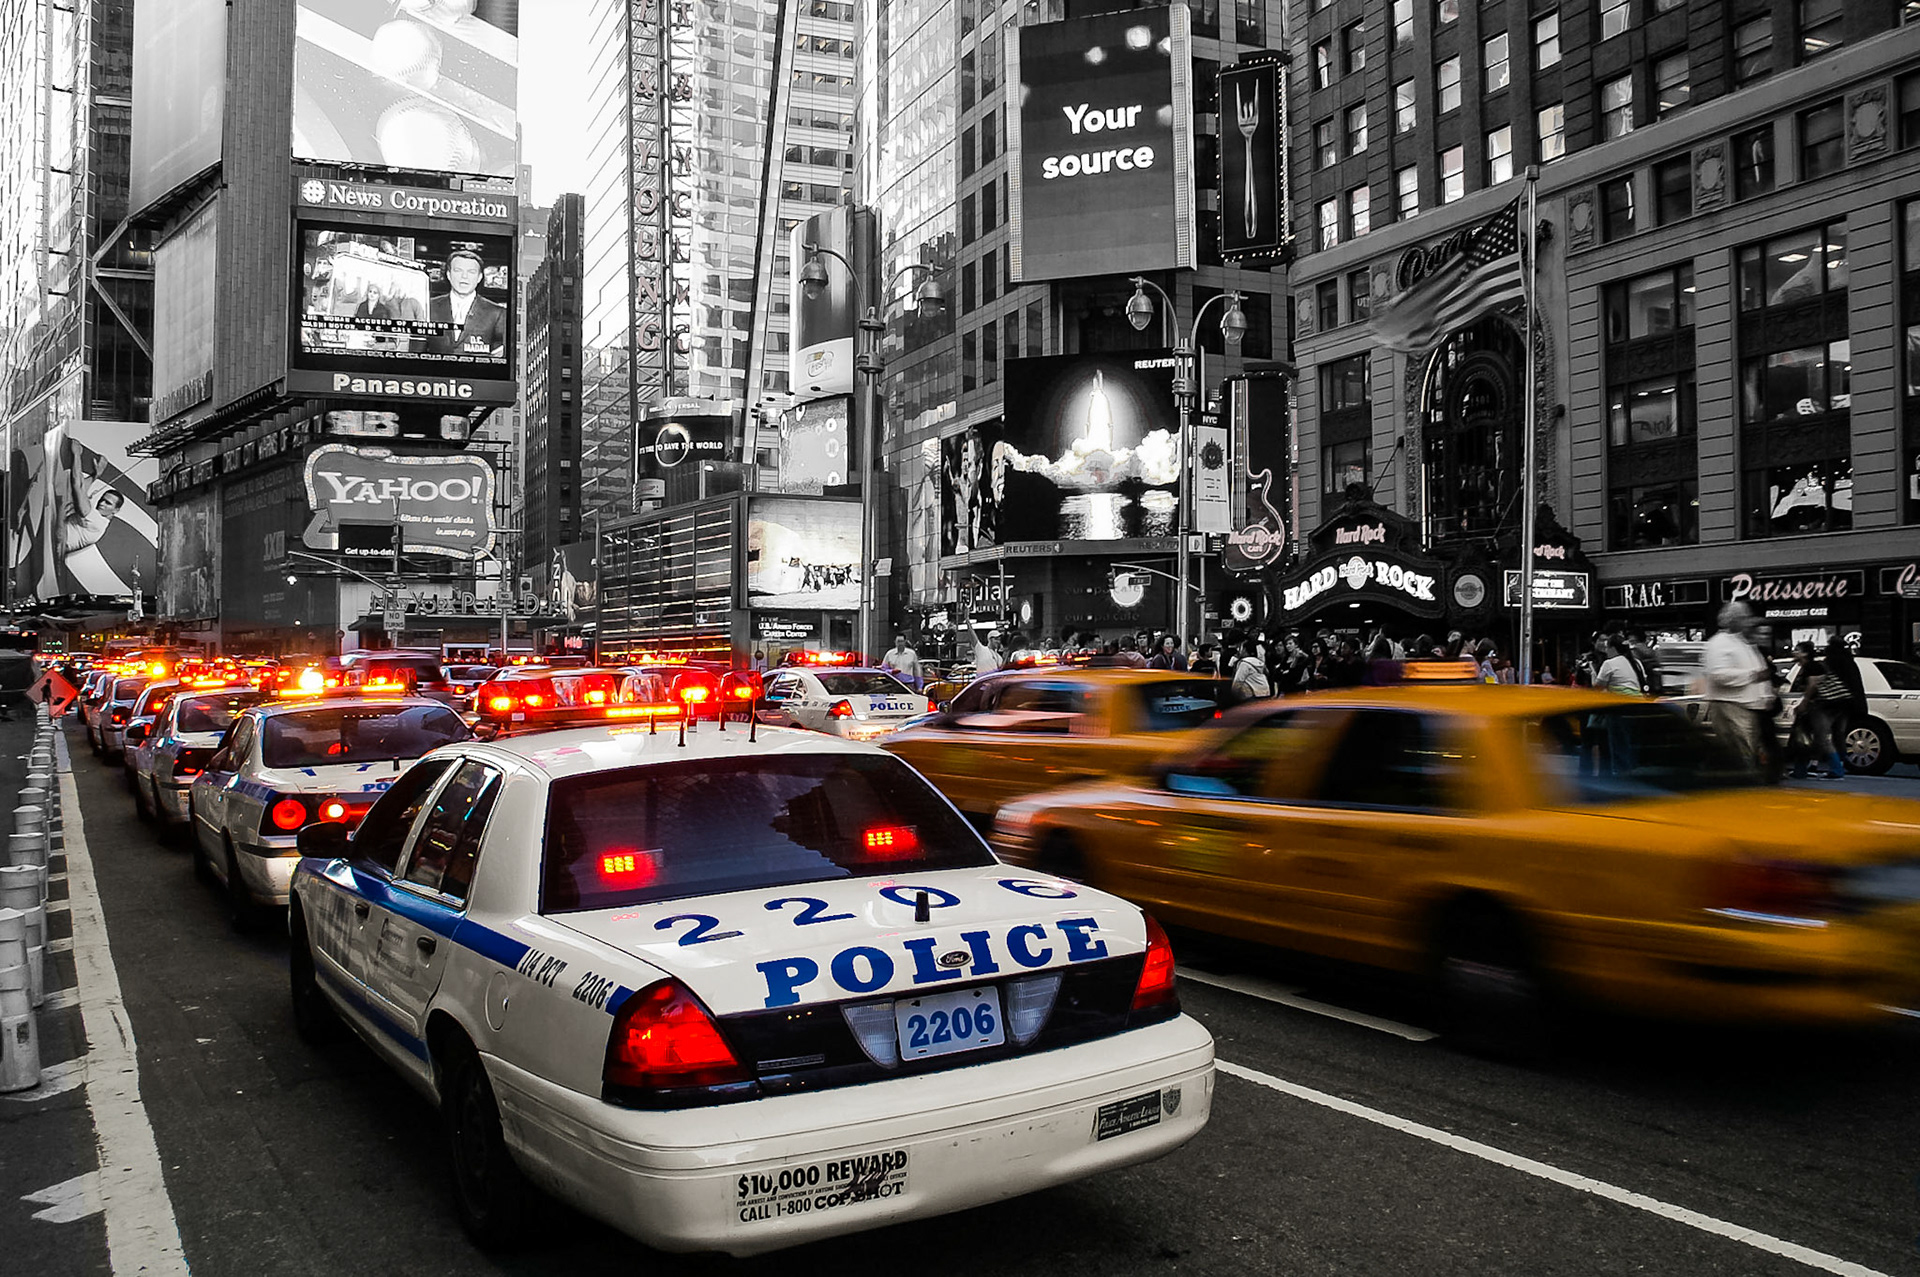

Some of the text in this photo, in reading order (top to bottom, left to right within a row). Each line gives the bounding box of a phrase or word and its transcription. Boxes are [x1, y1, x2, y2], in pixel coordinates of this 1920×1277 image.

[1062, 103, 1143, 135] Your
[1041, 145, 1156, 180] source
[329, 184, 508, 218] News Corporation
[333, 373, 474, 398] Panasonic
[696, 441, 724, 450] WORLD
[317, 471, 483, 504] YAHOO!
[1006, 544, 1053, 554] REUTERS
[1336, 522, 1386, 545] Hard Rock
[1283, 561, 1436, 610] HARD ROCK
[1624, 582, 1666, 609] R.A.G.
[1731, 573, 1848, 604] Patisserie
[385, 620, 405, 629] TURNS
[388, 612, 402, 620] NO
[869, 702, 914, 712] POLICE
[757, 917, 1109, 1008] POLICE
[518, 949, 614, 1009] 114 PCT 2206
[907, 1004, 996, 1048] 2206
[737, 1150, 908, 1199] $10,000 REWARD
[739, 1207, 772, 1223] CALL
[776, 1197, 811, 1218] 1-800
